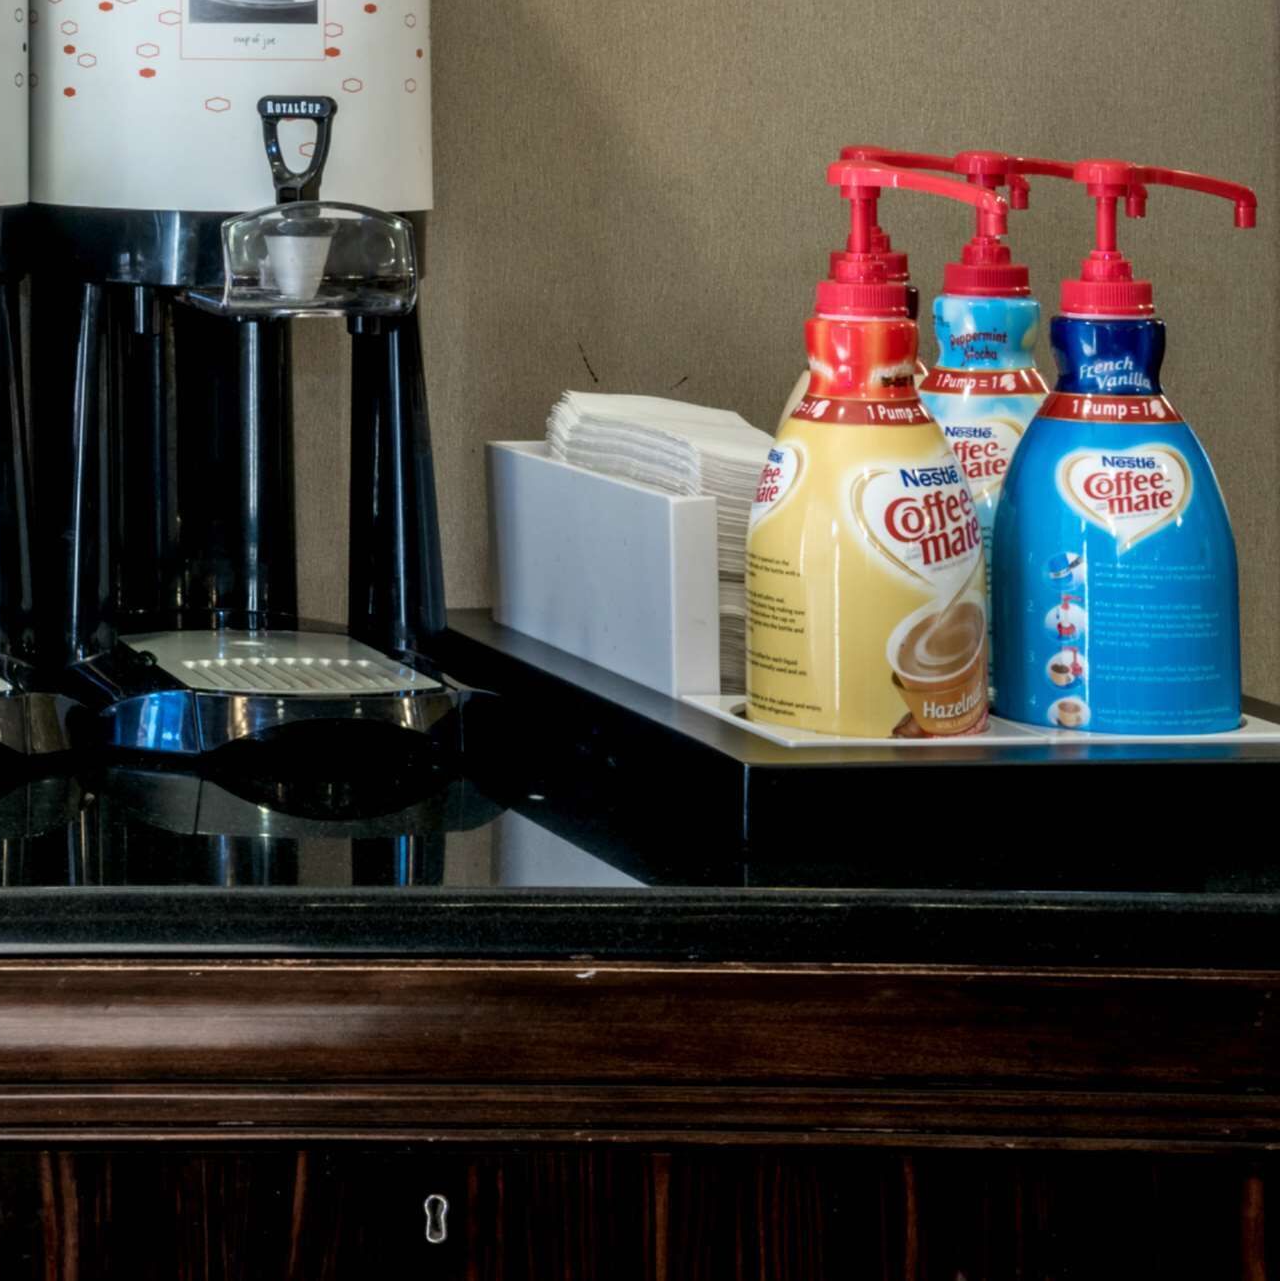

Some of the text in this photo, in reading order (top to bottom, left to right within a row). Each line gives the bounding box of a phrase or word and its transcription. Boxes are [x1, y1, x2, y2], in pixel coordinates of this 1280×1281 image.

[950, 328, 1008, 350] Peppermint
[961, 345, 999, 367] Mocha
[1079, 355, 1134, 380] French
[943, 373, 977, 390] Pump
[1095, 371, 1152, 391] Vanilla
[877, 403, 913, 423] Pump
[1082, 398, 1128, 419] Pump
[962, 458, 1007, 478] ate
[1101, 455, 1156, 469] Nestlé
[899, 465, 959, 488] Nestlé
[754, 485, 779, 503] ate
[1107, 490, 1173, 514] mate
[920, 516, 981, 566] mate
